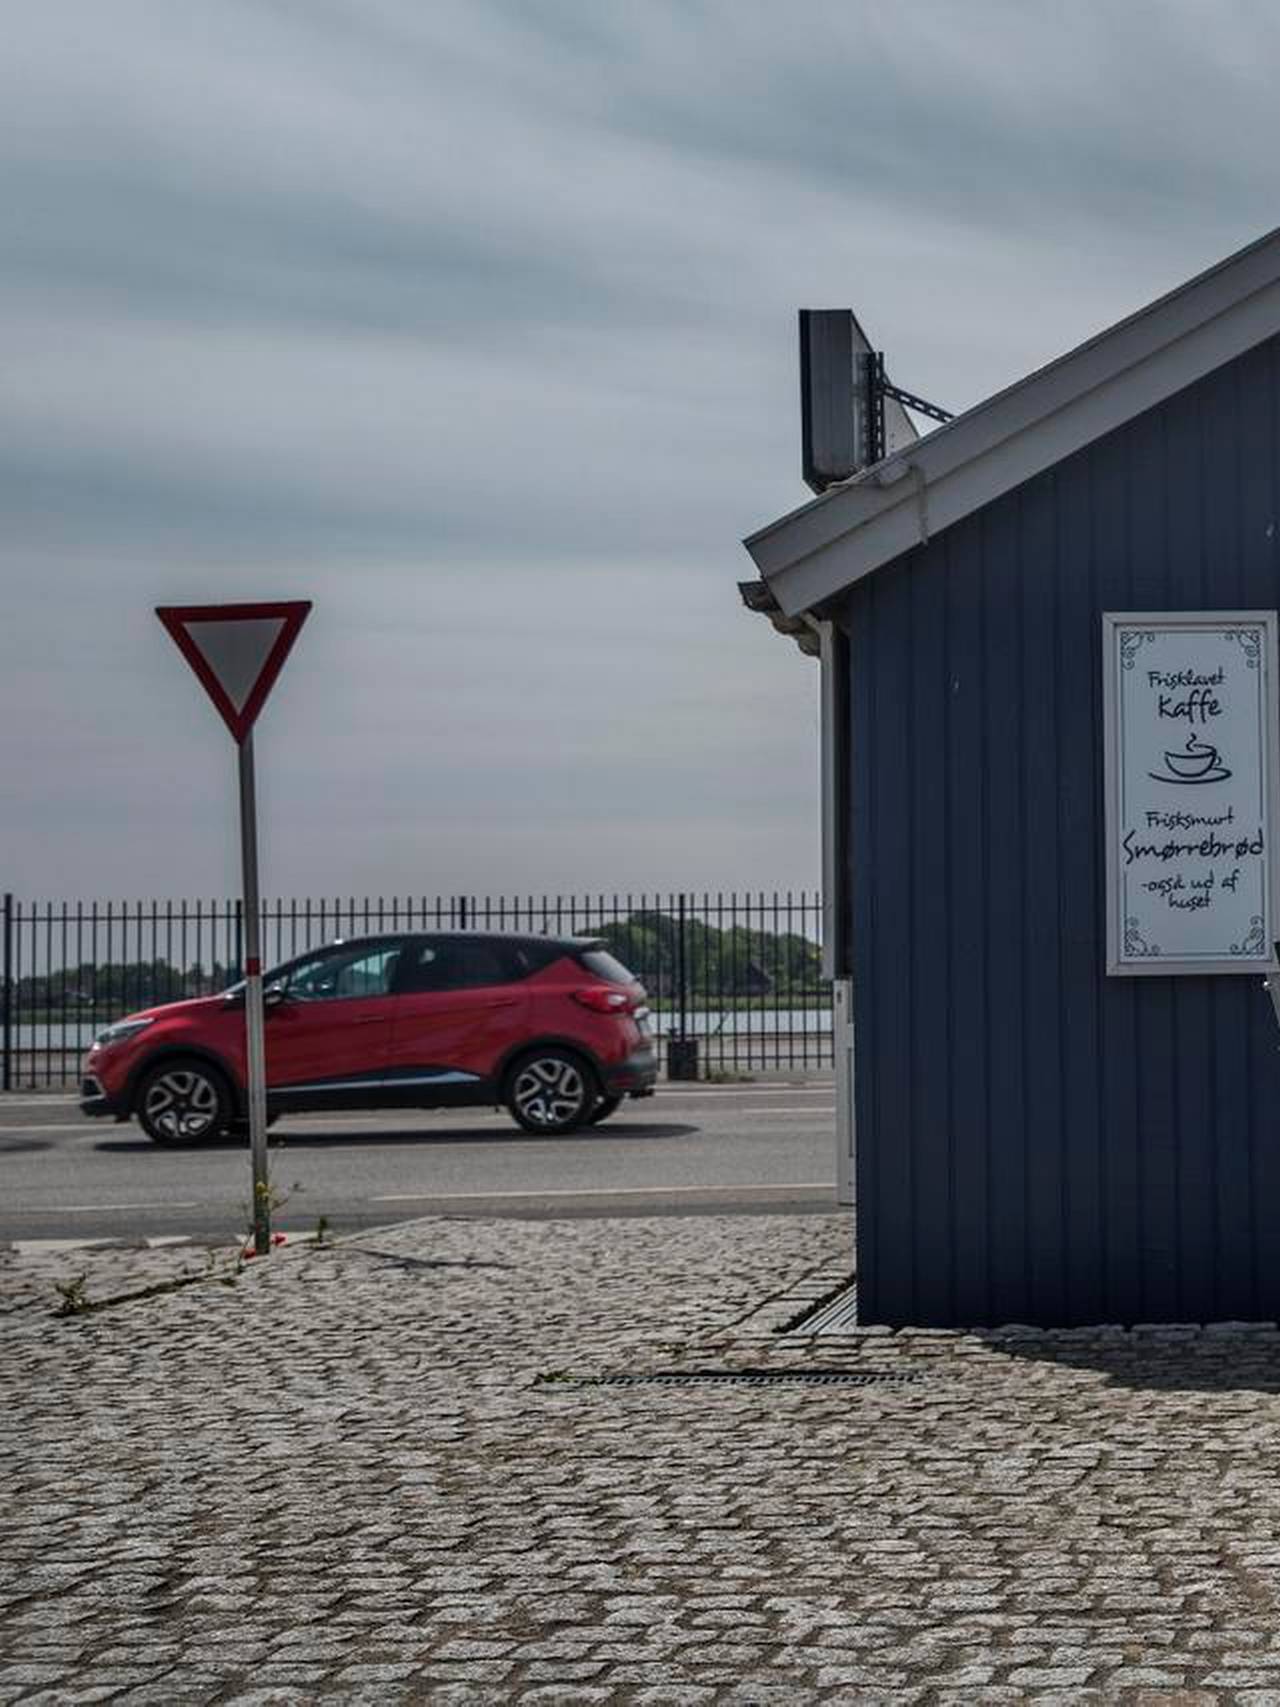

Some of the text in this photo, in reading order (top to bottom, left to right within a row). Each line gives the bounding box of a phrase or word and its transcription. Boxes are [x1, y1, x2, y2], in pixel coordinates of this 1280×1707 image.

[1148, 666, 1226, 690] Frisklavet
[1158, 689, 1223, 724] Kaffe
[1144, 807, 1234, 830] Frisksmurt
[1122, 828, 1264, 864] Smørrebrød
[1192, 872, 1214, 890] ud
[1221, 870, 1240, 893] af
[1169, 889, 1211, 912] huset
